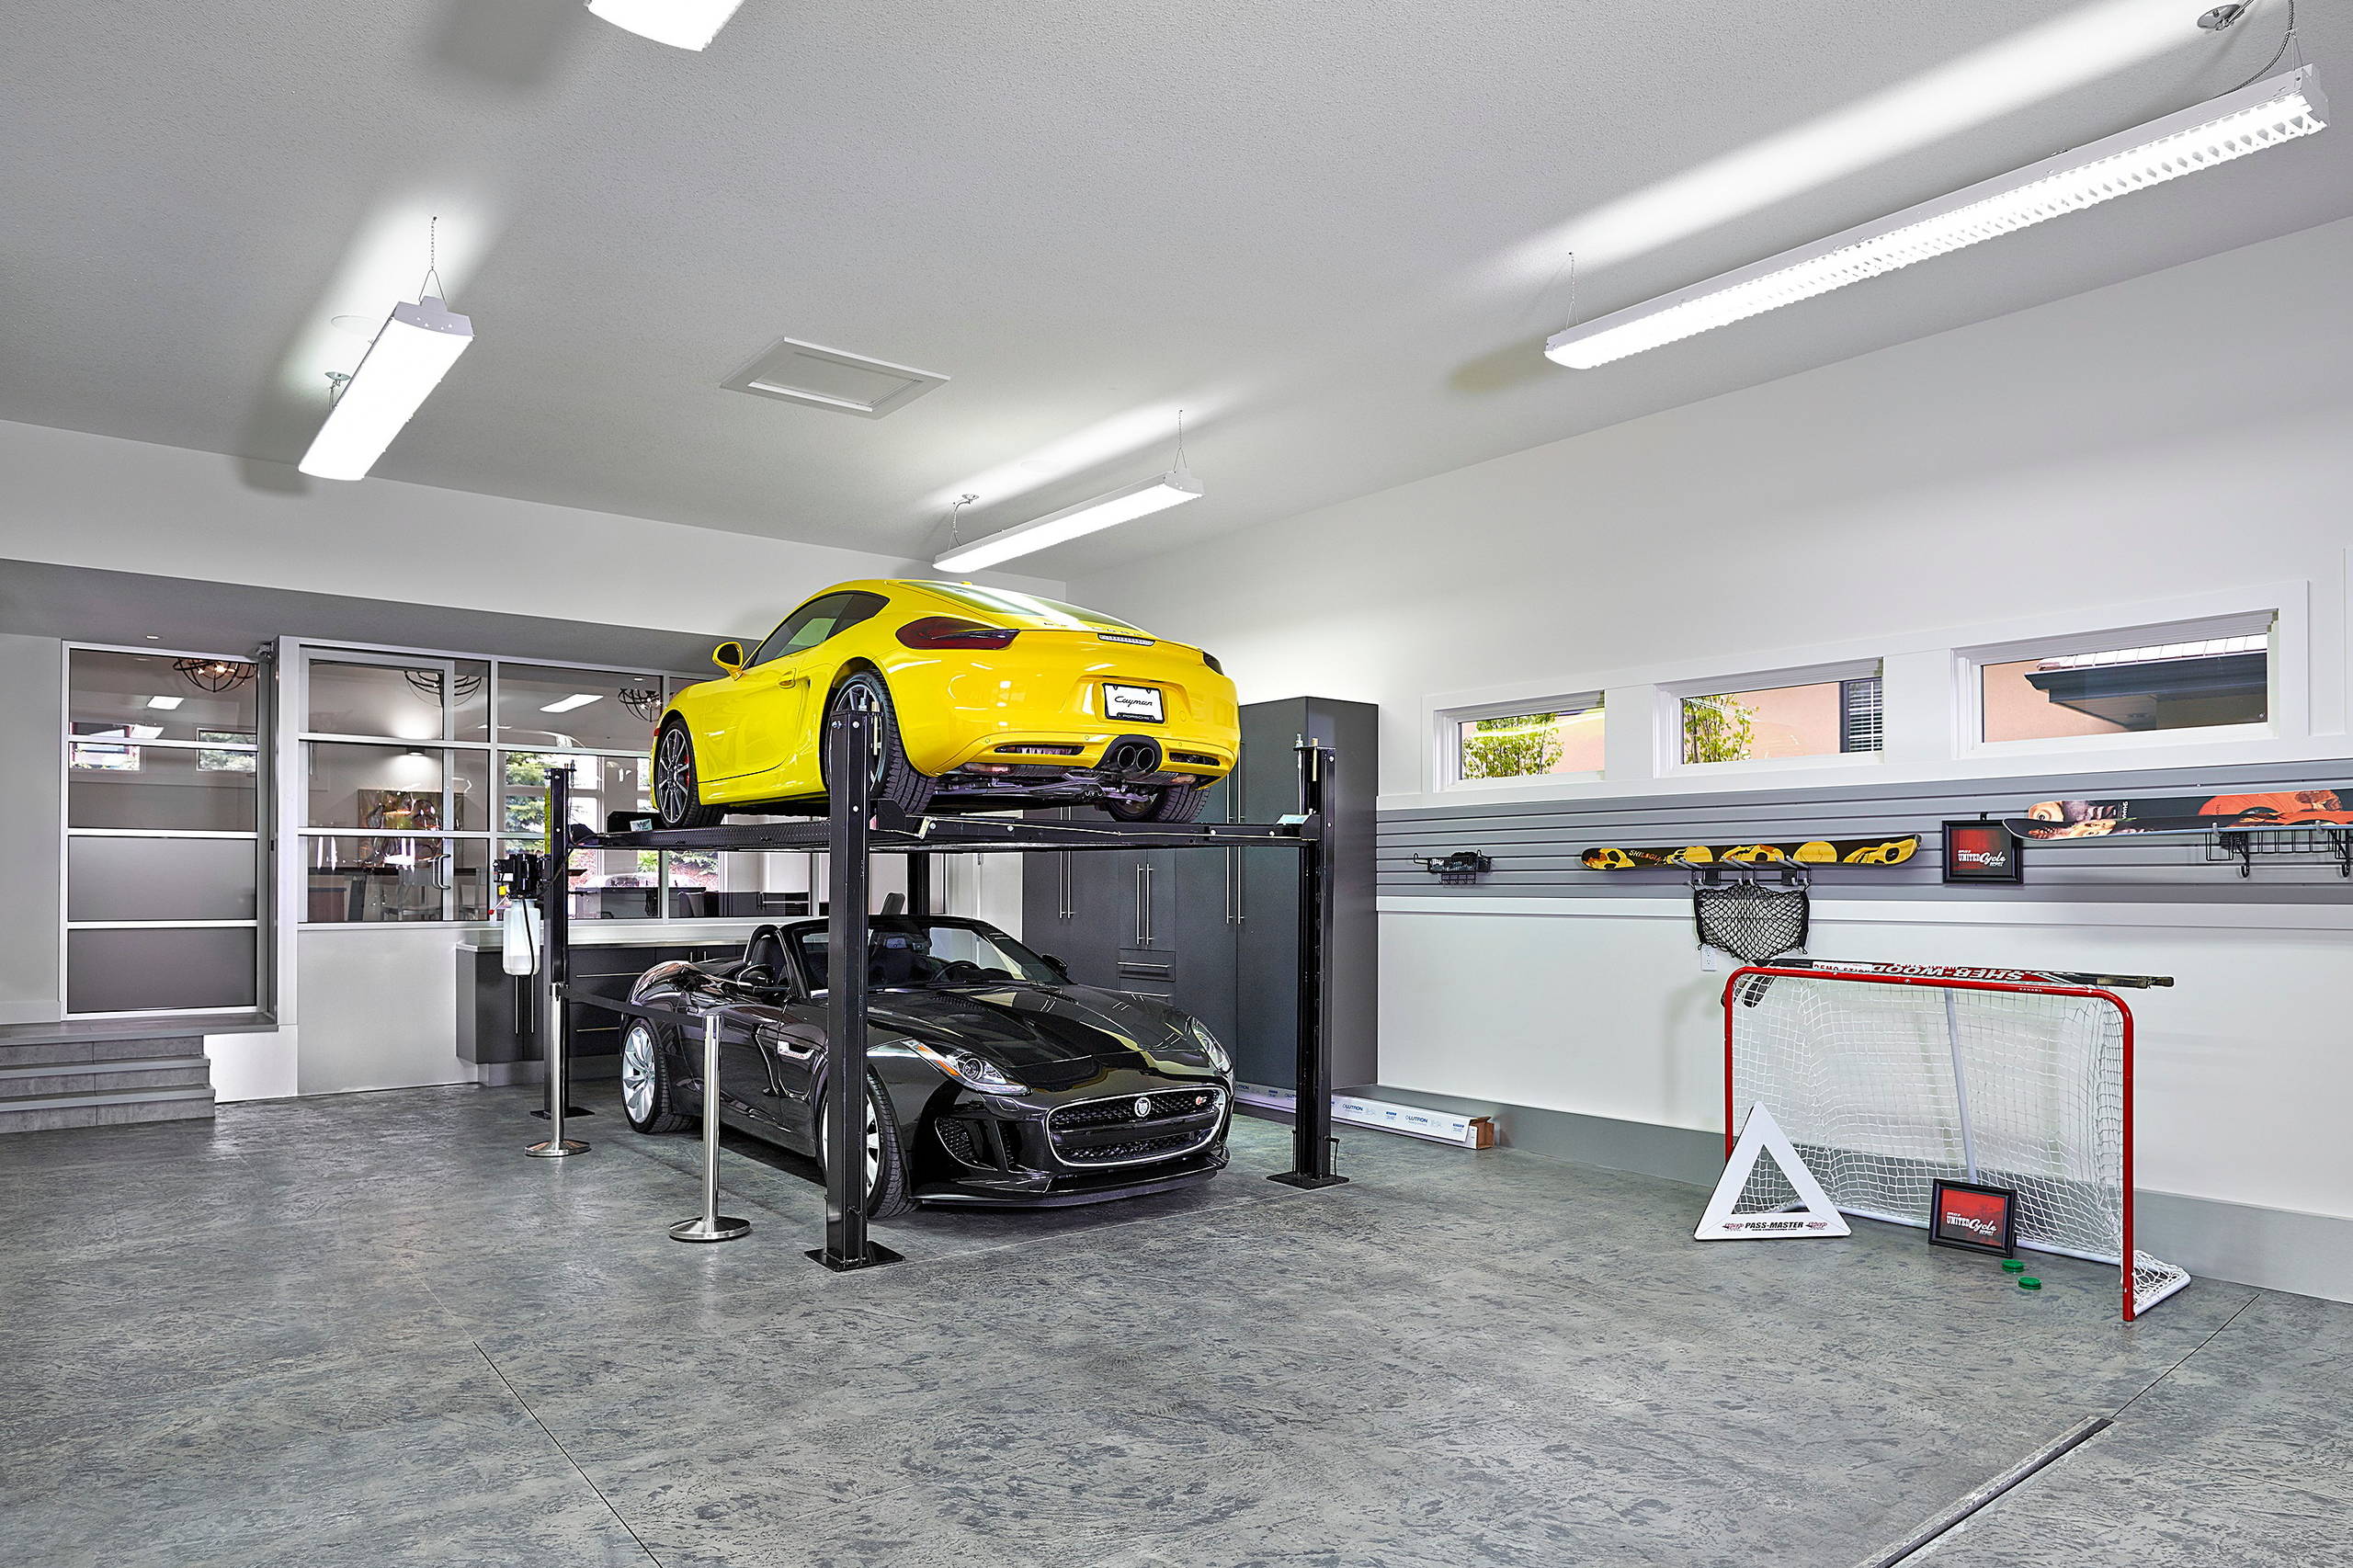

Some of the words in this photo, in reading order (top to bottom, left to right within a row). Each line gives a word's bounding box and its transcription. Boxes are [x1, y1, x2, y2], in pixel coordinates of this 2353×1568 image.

[1114, 696, 1153, 708] Cayman
[1958, 853, 1981, 862] UNITED
[1979, 851, 2006, 866] Cycle
[1871, 964, 2023, 981] SHER-WOOD
[1946, 1215, 1971, 1227] UNITED
[1969, 1219, 1997, 1232] Cycle
